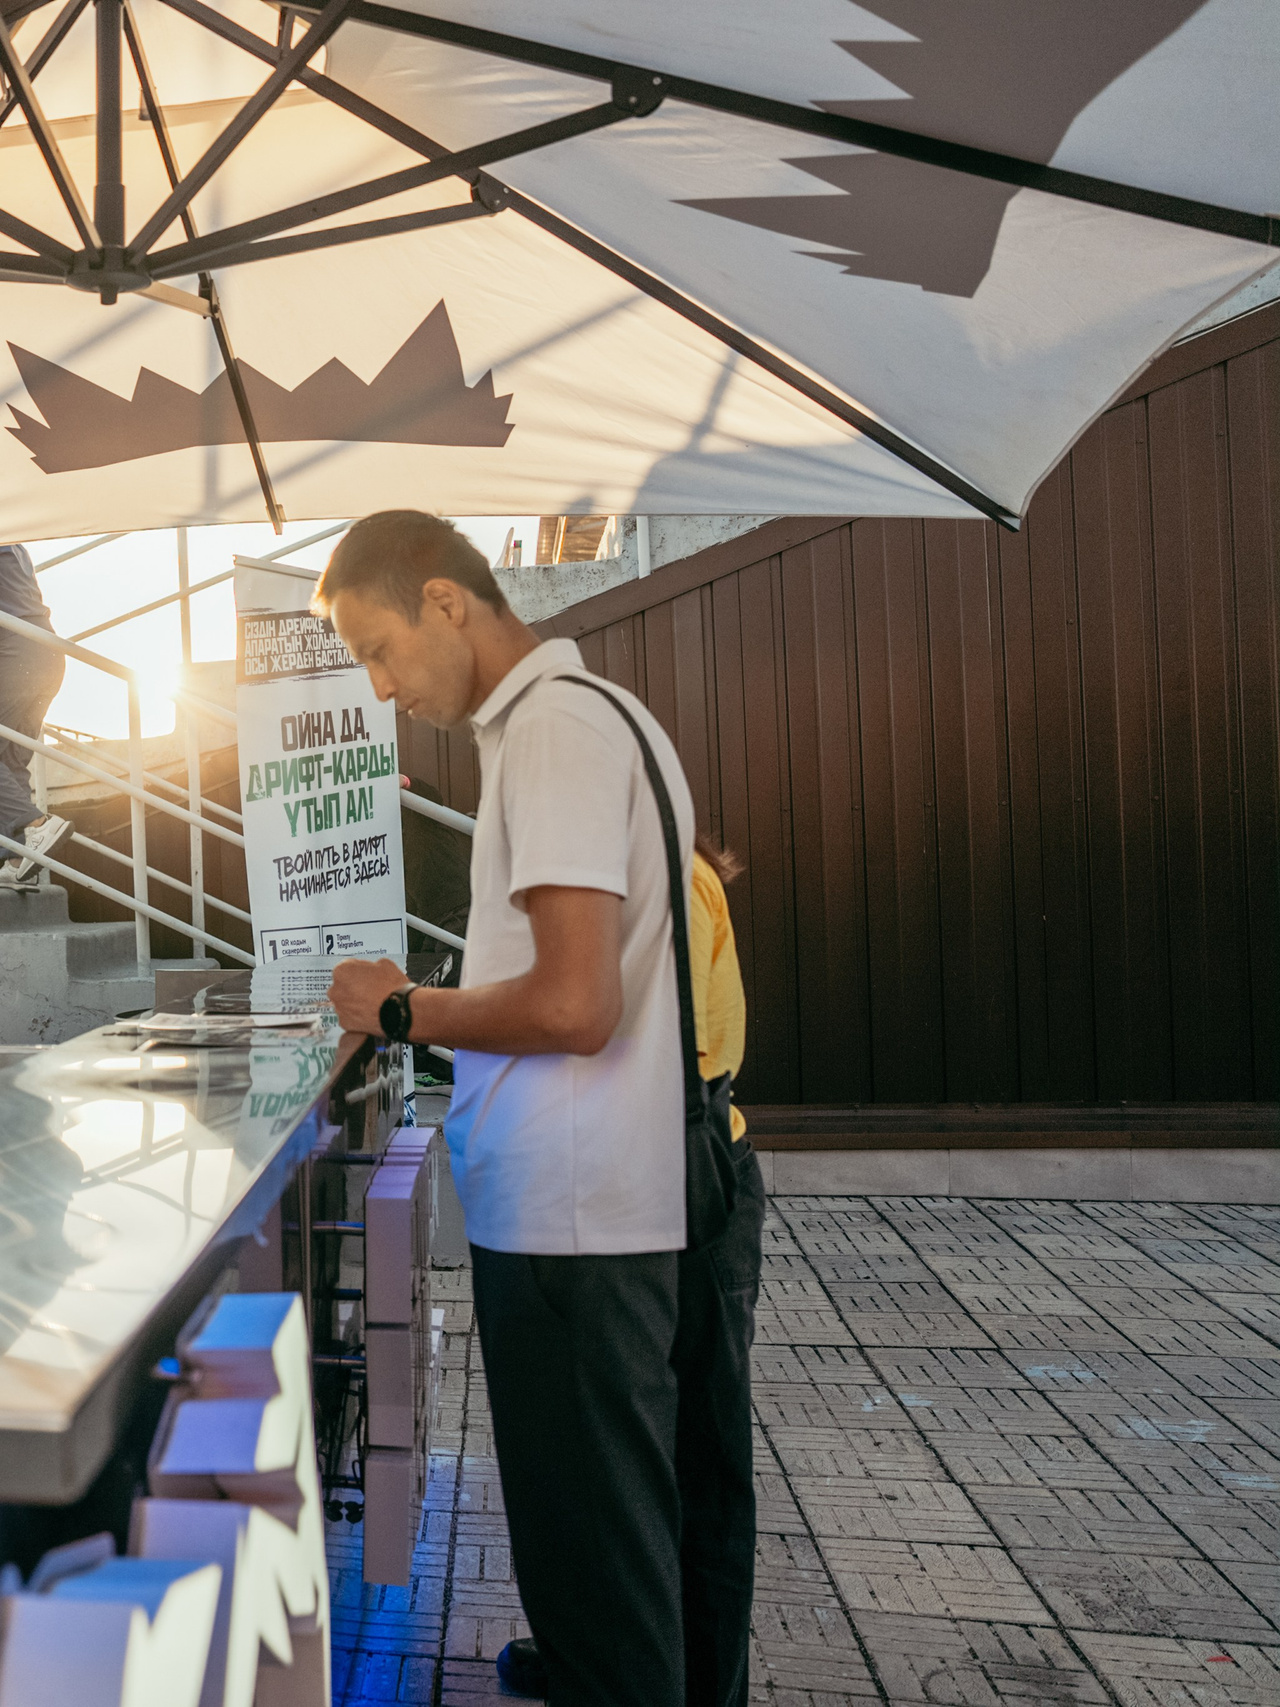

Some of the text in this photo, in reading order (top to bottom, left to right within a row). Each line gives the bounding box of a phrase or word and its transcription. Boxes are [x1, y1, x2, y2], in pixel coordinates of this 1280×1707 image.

[244, 635, 303, 657] АПАРАТЫН
[278, 616, 324, 636] ДРЕЙФКЕ
[244, 648, 358, 676] ОСЫ ЖЕРДЕН БАСТАЛА
[281, 706, 370, 752] ОЙНА ДА,
[246, 742, 396, 803] ДРИФТ-КАРДЫ
[346, 785, 374, 825] АЛ!
[272, 833, 387, 880] ТВОЙ ПУТЬ В ДРИФТ
[279, 854, 390, 902] НАЧИНАЕТСЯ ЗДЕСЬ!
